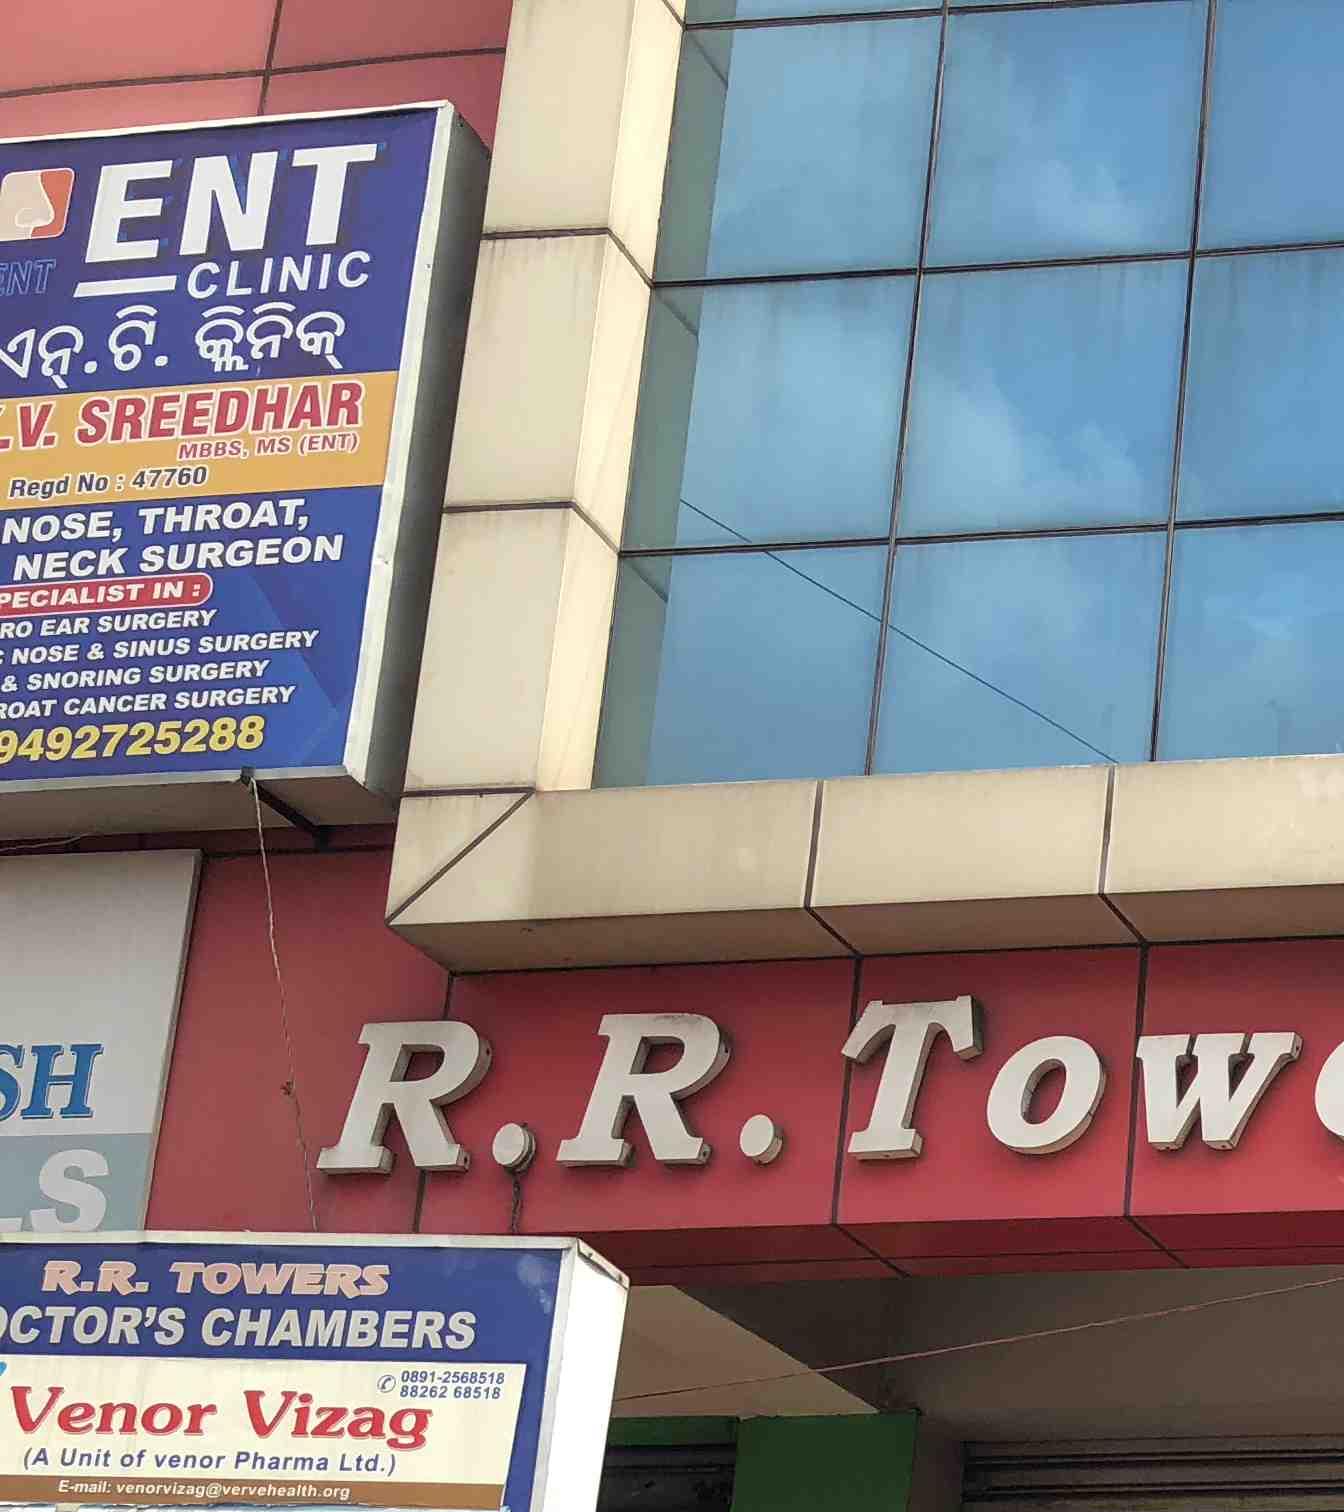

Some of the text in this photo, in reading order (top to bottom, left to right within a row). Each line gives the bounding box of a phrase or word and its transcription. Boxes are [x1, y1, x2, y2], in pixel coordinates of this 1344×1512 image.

[85, 144, 378, 262] ENT
[187, 251, 370, 299] CLINIC
[77, 381, 364, 444] SREEDHAR
[178, 433, 359, 460] MBBS, MS (ENT)
[9, 465, 207, 499] Regd No 47760
[2, 498, 309, 544] NOSE, THROAT,
[13, 534, 344, 581] NECK SURGEON
[26, 660, 270, 691] SNORING SURGERY
[0, 716, 266, 765] 9492725288
[316, 1012, 785, 1175] R.R.
[42, 1260, 391, 1299] R.R. TOWERS
[201, 1308, 477, 1350] CHAMBERS
[401, 1369, 505, 1386] 0891-2568518
[10, 1385, 432, 1450] Venor Vizag
[234, 1451, 397, 1476] Pharma Ltd.)
[57, 1480, 352, 1501] E-mail: venorvizag@vervehealth.org
